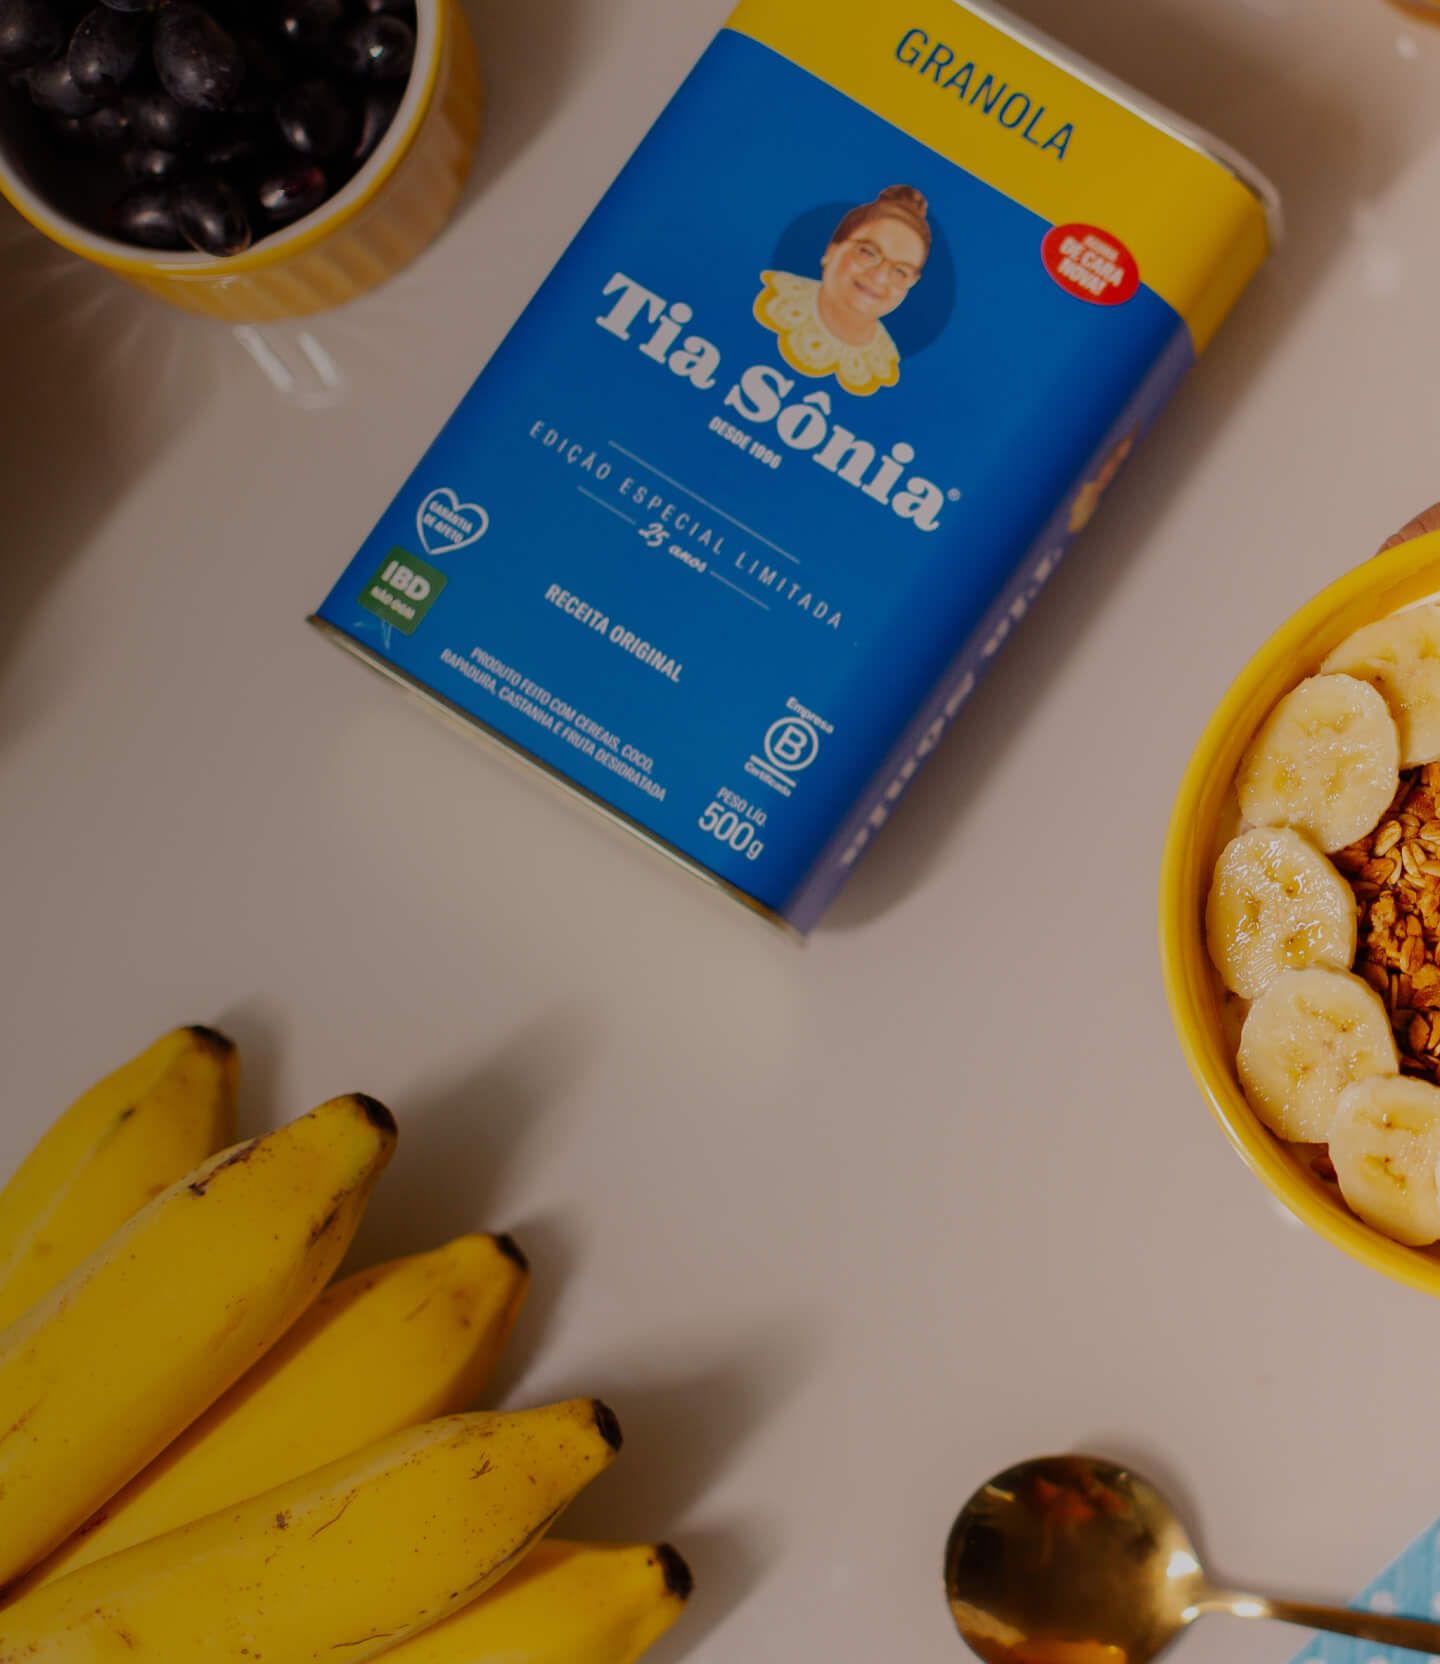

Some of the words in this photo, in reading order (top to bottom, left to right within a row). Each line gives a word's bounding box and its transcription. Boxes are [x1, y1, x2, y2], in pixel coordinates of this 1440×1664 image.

[894, 28, 1074, 160] GRANOLA
[596, 272, 720, 389] Tia
[724, 365, 945, 532] Sônia
[709, 416, 751, 450] DESDE
[748, 441, 782, 469] 1996
[424, 514, 437, 527] DE
[435, 520, 464, 543] AFETO
[429, 501, 473, 534] GARANTIA
[529, 420, 611, 480] EDIÇÃO
[619, 478, 724, 555] ESPECIAL
[735, 552, 842, 629] LIMITADA
[638, 522, 670, 547] 25
[668, 544, 707, 572] anos
[381, 560, 430, 601] IBD
[545, 583, 609, 634] RECEITA
[609, 625, 683, 683] ORIGINAL
[440, 648, 498, 695] RAPADURA,
[498, 687, 554, 729] CASTANHA
[552, 721, 562, 735] E
[561, 726, 596, 756] FRUTA
[594, 748, 667, 801] DESIDRATADA
[471, 647, 522, 686] PRODUTO
[520, 679, 551, 705] FEITO
[550, 698, 576, 722] COM
[574, 714, 620, 752] CEREAIS,
[621, 745, 653, 774] COCO,
[786, 696, 834, 734] Empresa
[774, 725, 808, 761] B
[717, 787, 748, 813] PESO
[744, 761, 792, 797] Certificada
[698, 801, 764, 860] 500g
